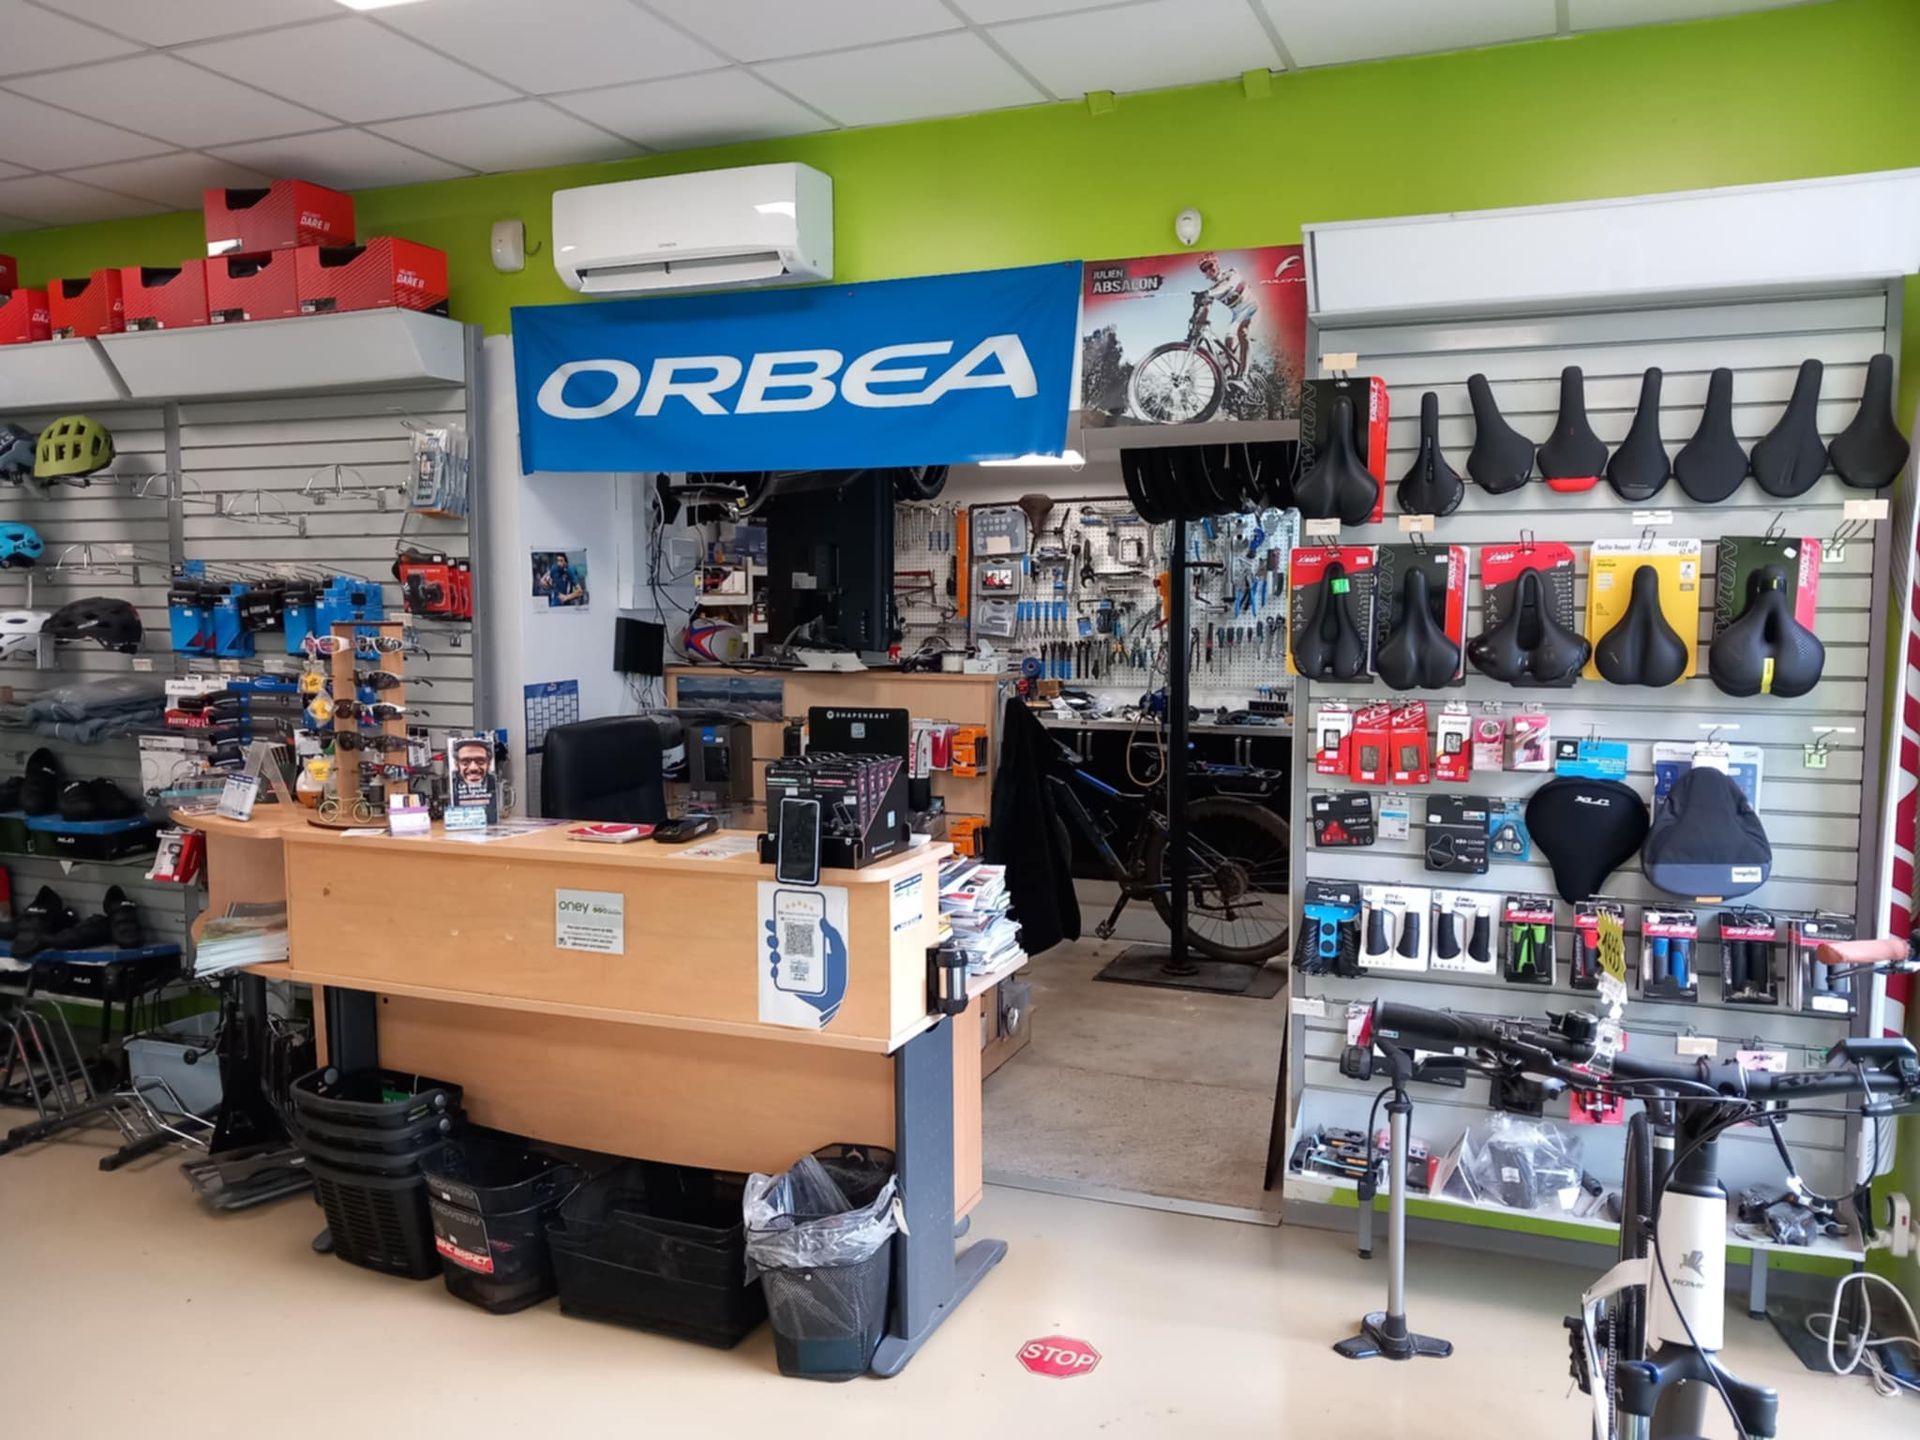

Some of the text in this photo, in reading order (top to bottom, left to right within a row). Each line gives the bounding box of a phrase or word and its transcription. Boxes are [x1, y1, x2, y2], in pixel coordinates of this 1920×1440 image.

[300, 215, 323, 230] DARE
[396, 272, 418, 287] DARE
[1093, 269, 1123, 279] JULIEN
[1093, 277, 1158, 294] ABSALON
[536, 333, 1039, 421] ORBEA
[836, 712, 890, 720] SHAPEHEART
[1356, 708, 1391, 725] KLS
[1391, 706, 1424, 726] KLS
[558, 900, 589, 914] oney
[1023, 1343, 1096, 1368] STOP
